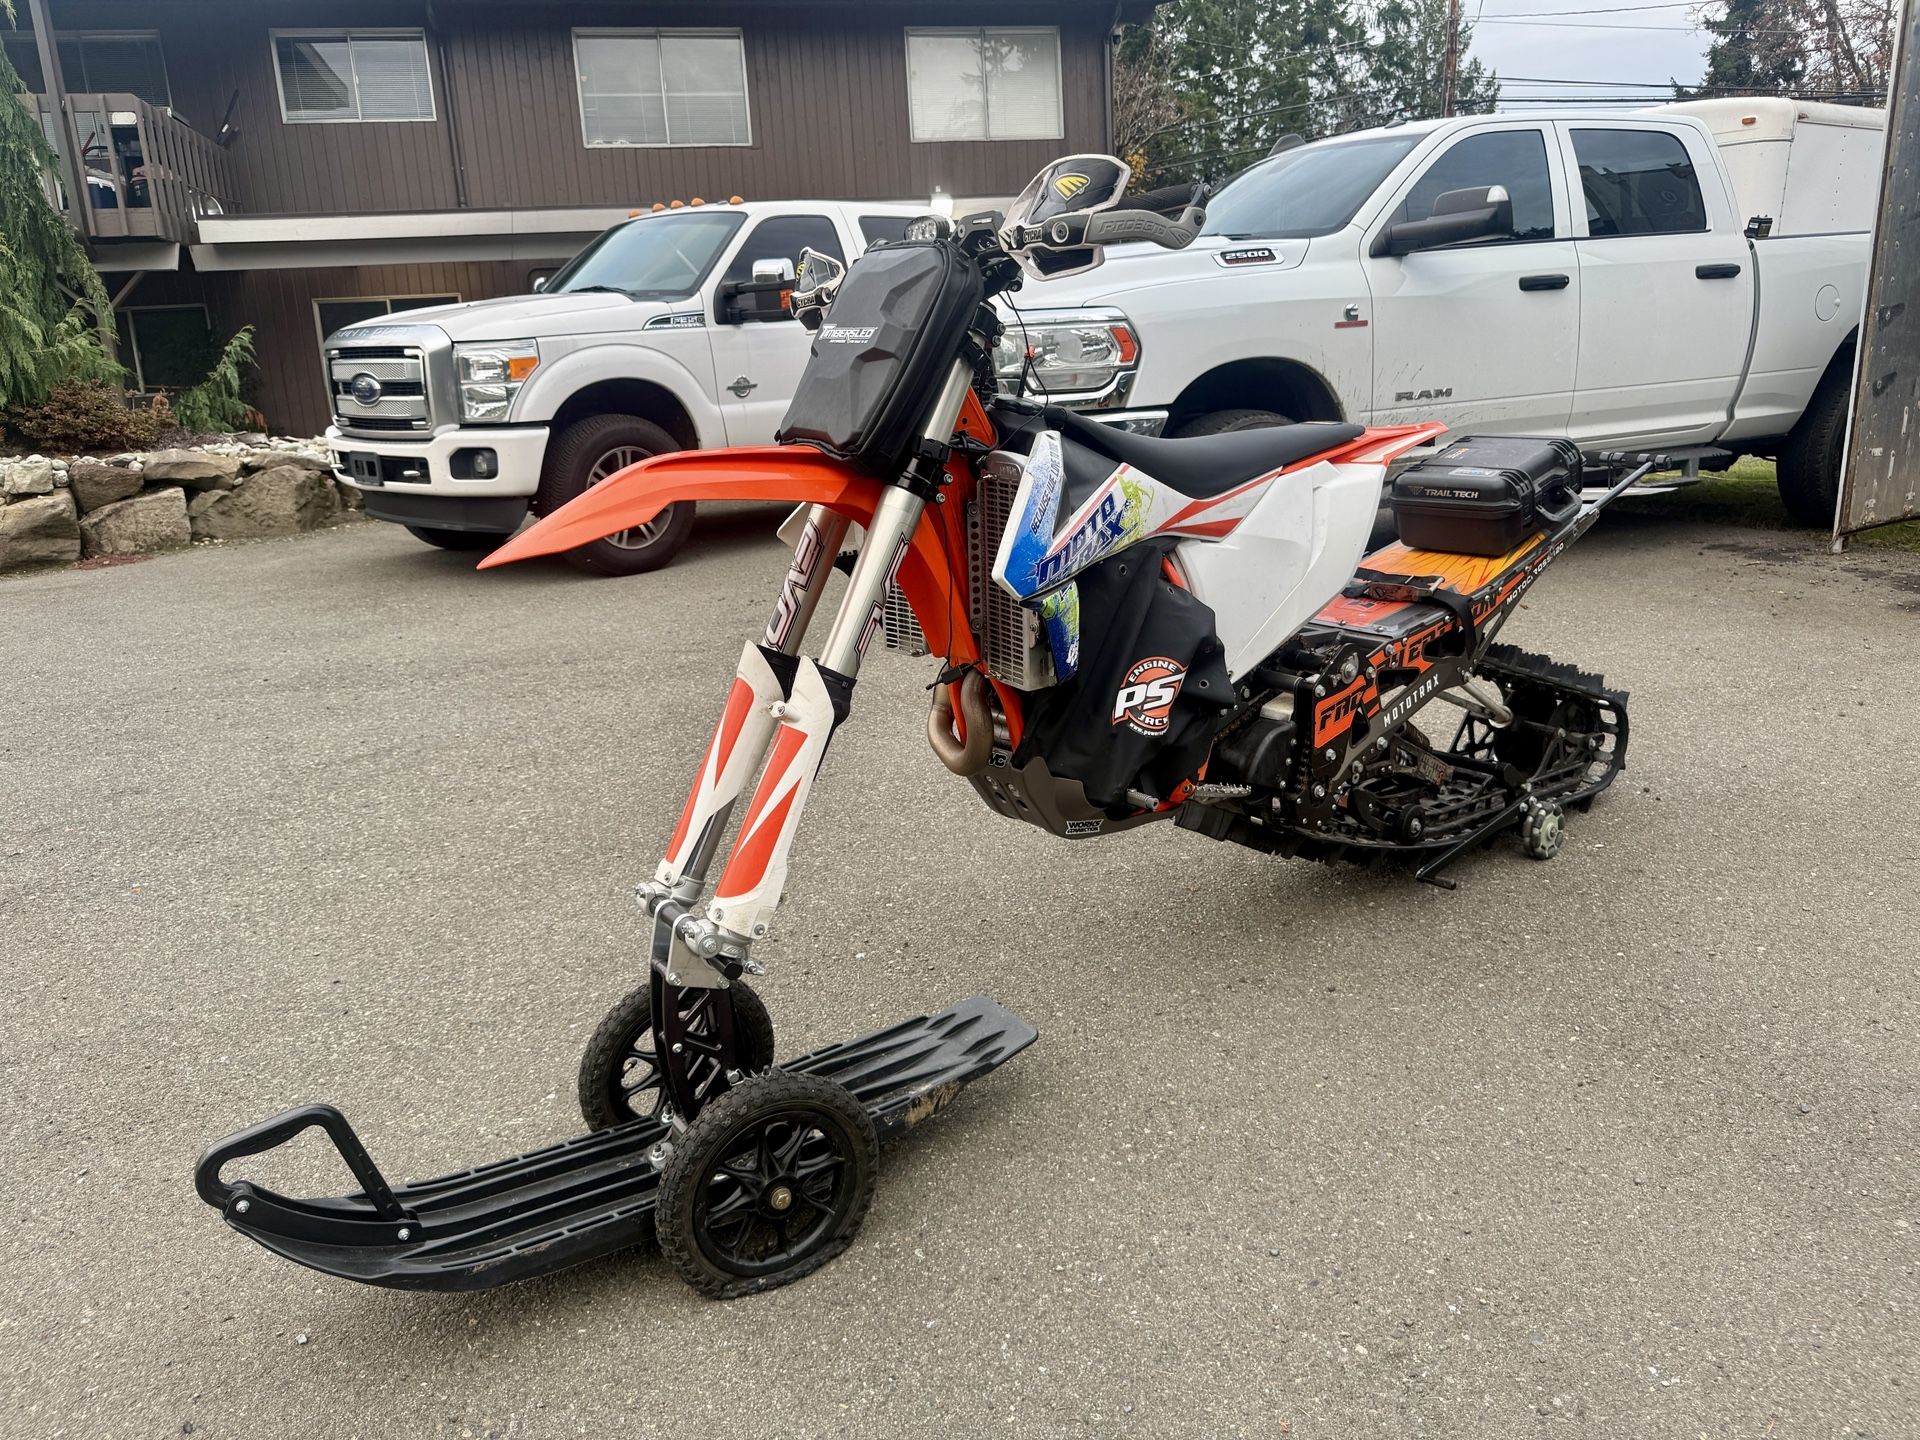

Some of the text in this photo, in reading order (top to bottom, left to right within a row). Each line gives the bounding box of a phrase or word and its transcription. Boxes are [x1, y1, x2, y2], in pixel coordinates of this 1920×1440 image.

[1023, 228, 1043, 242] CYCRA
[1225, 250, 1269, 260] 2500
[1395, 387, 1453, 402] RAM
[1425, 488, 1479, 499] TRAIL TECH
[1031, 490, 1051, 535] BECAUSE
[1047, 473, 1058, 493] WE
[1128, 660, 1177, 682] ENGINE
[1114, 671, 1187, 719] PS
[1383, 673, 1440, 728] MOTOTRAX
[1068, 820, 1102, 828] WORKS
